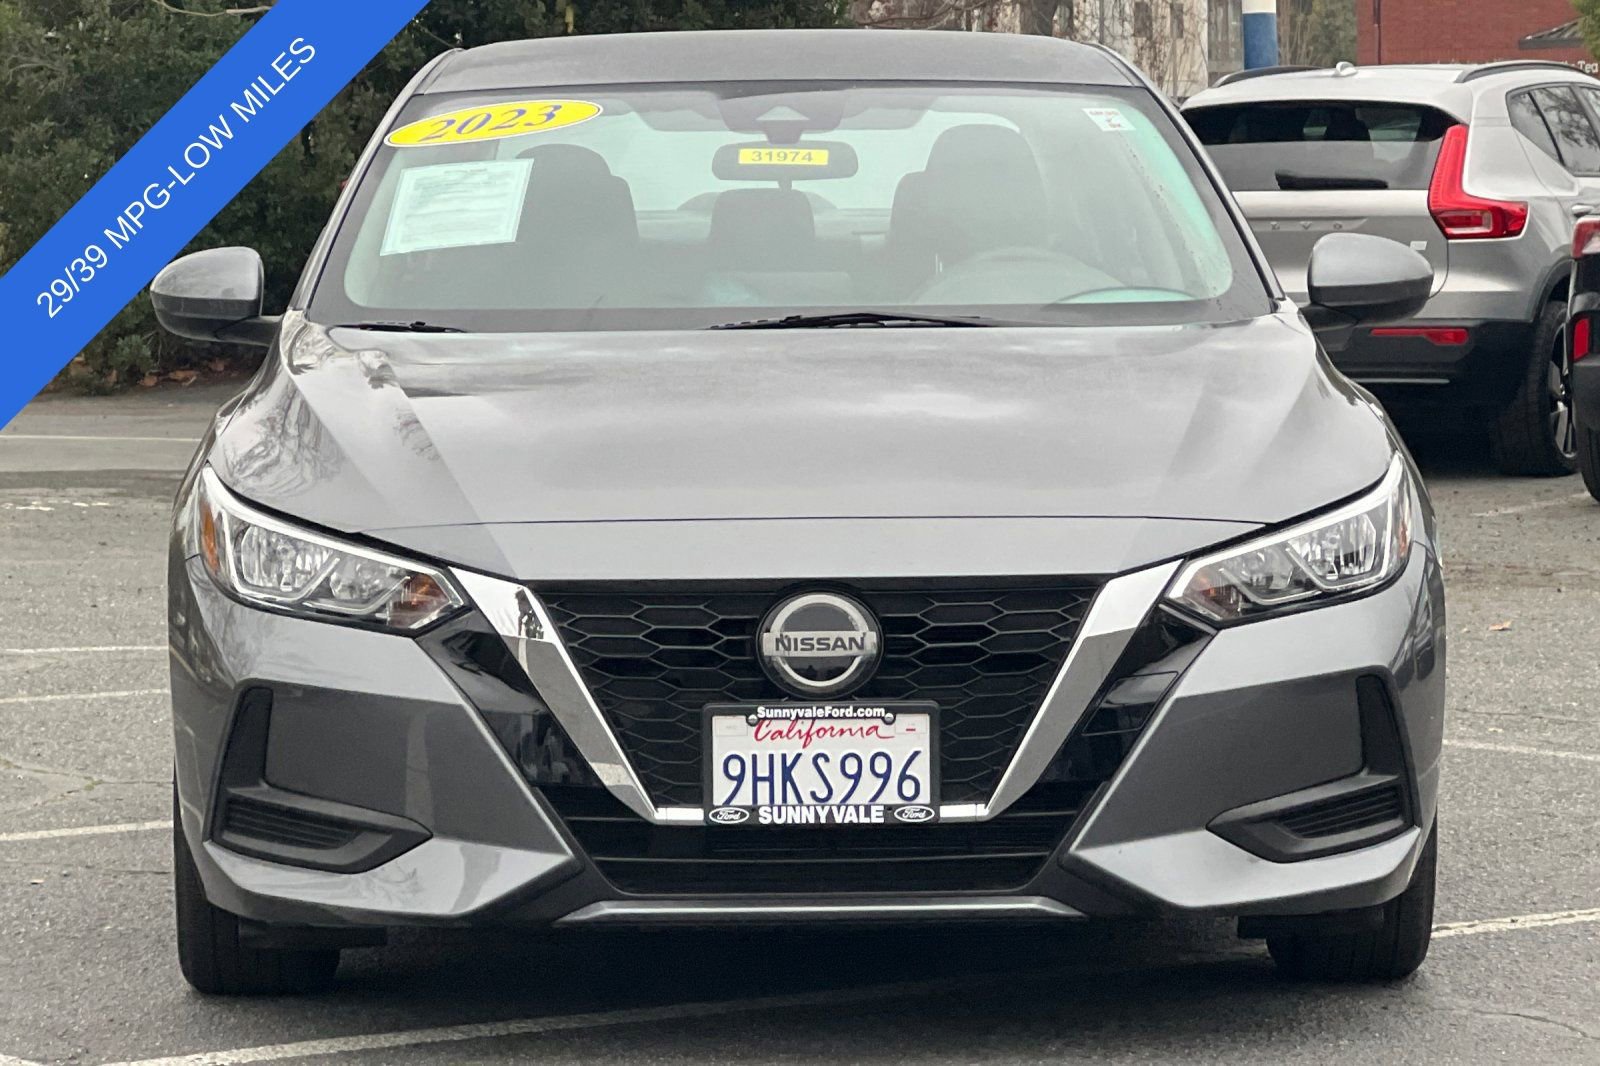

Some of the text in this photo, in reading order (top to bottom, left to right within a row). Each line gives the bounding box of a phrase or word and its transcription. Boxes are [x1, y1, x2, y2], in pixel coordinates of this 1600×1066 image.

[417, 104, 562, 142] 2023
[751, 150, 813, 162] 31974
[775, 635, 866, 652] NISSAN
[757, 706, 885, 719] SunnyvaleFord.com
[754, 718, 894, 749] California
[721, 750, 922, 806] 9HKS996
[716, 810, 741, 821] Ford
[758, 805, 885, 824] SUNNYVALE
[902, 809, 927, 820] Ford
